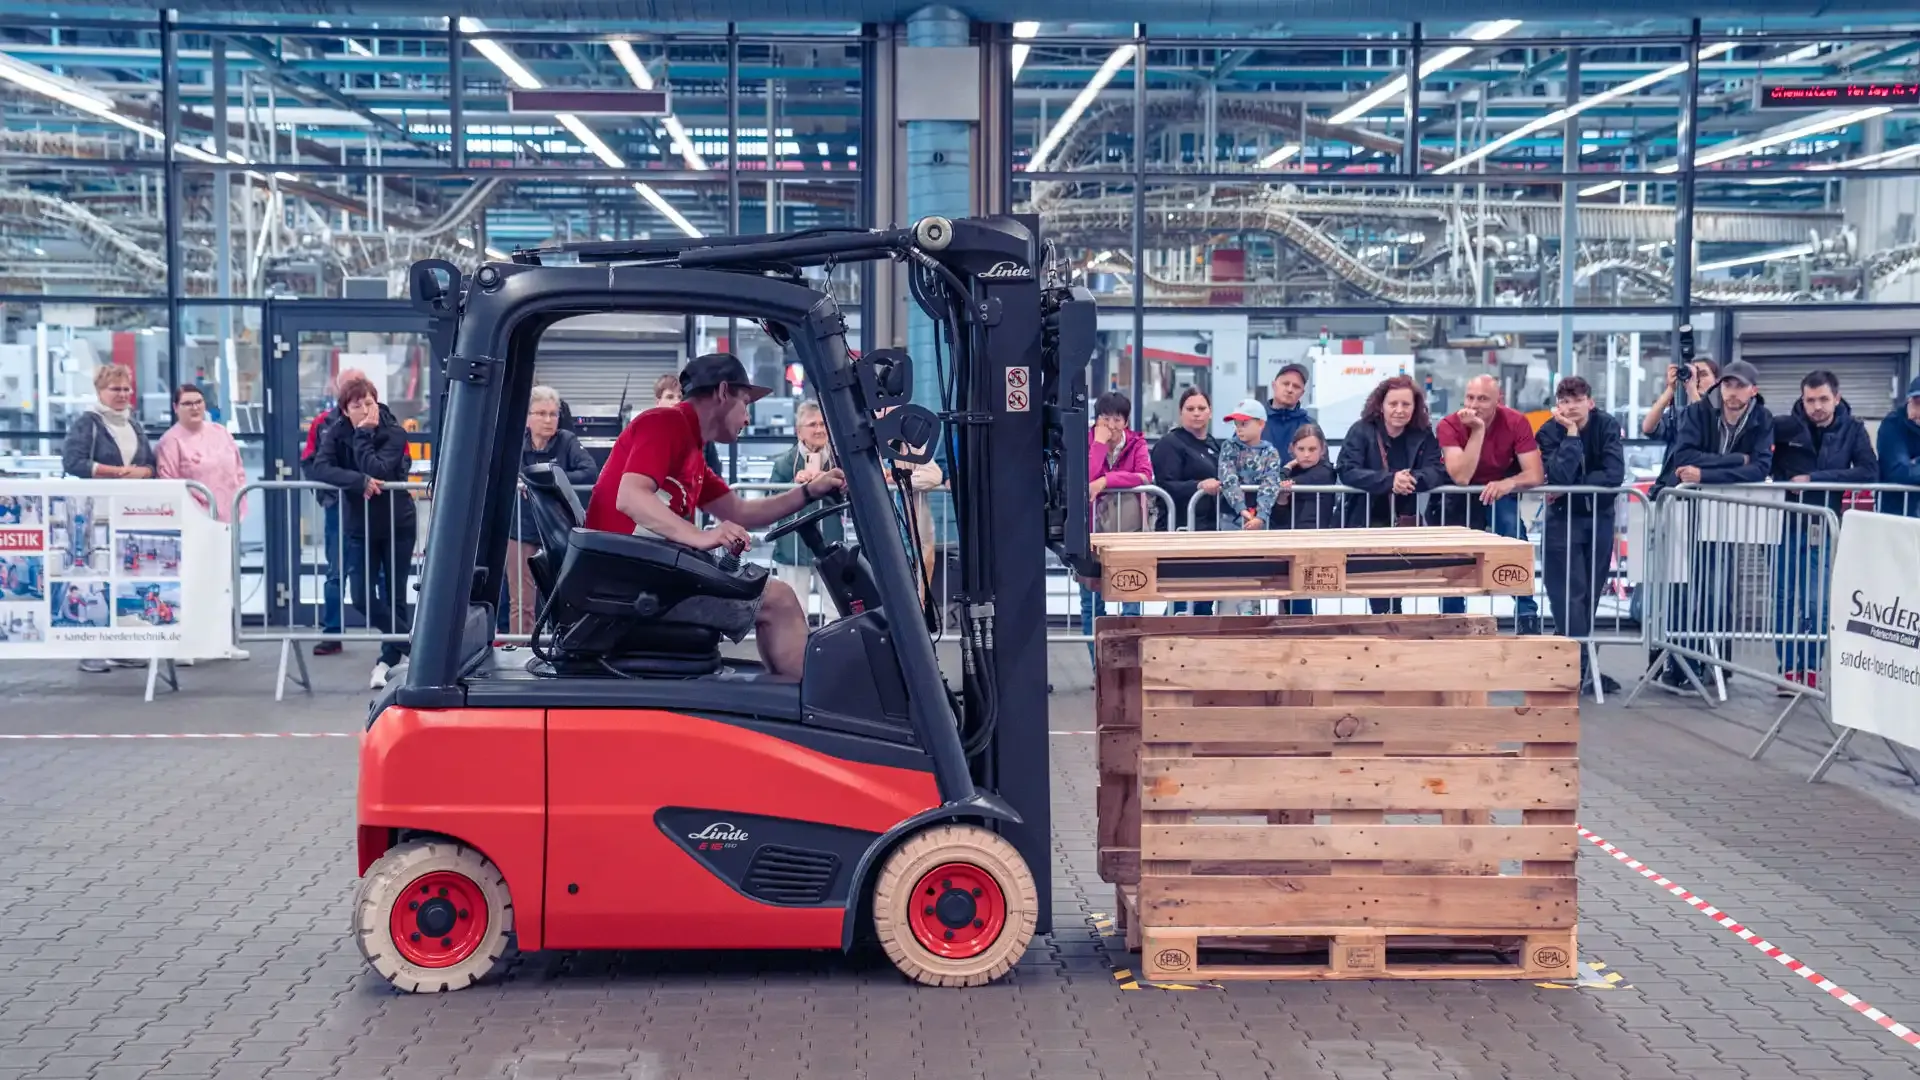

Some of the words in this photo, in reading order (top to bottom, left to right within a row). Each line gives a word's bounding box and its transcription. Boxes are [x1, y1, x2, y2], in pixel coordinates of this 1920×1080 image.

[977, 260, 1031, 278] Linde
[1116, 574, 1143, 587] EPAL
[1498, 569, 1525, 582] EPAL
[688, 822, 749, 841] Linde
